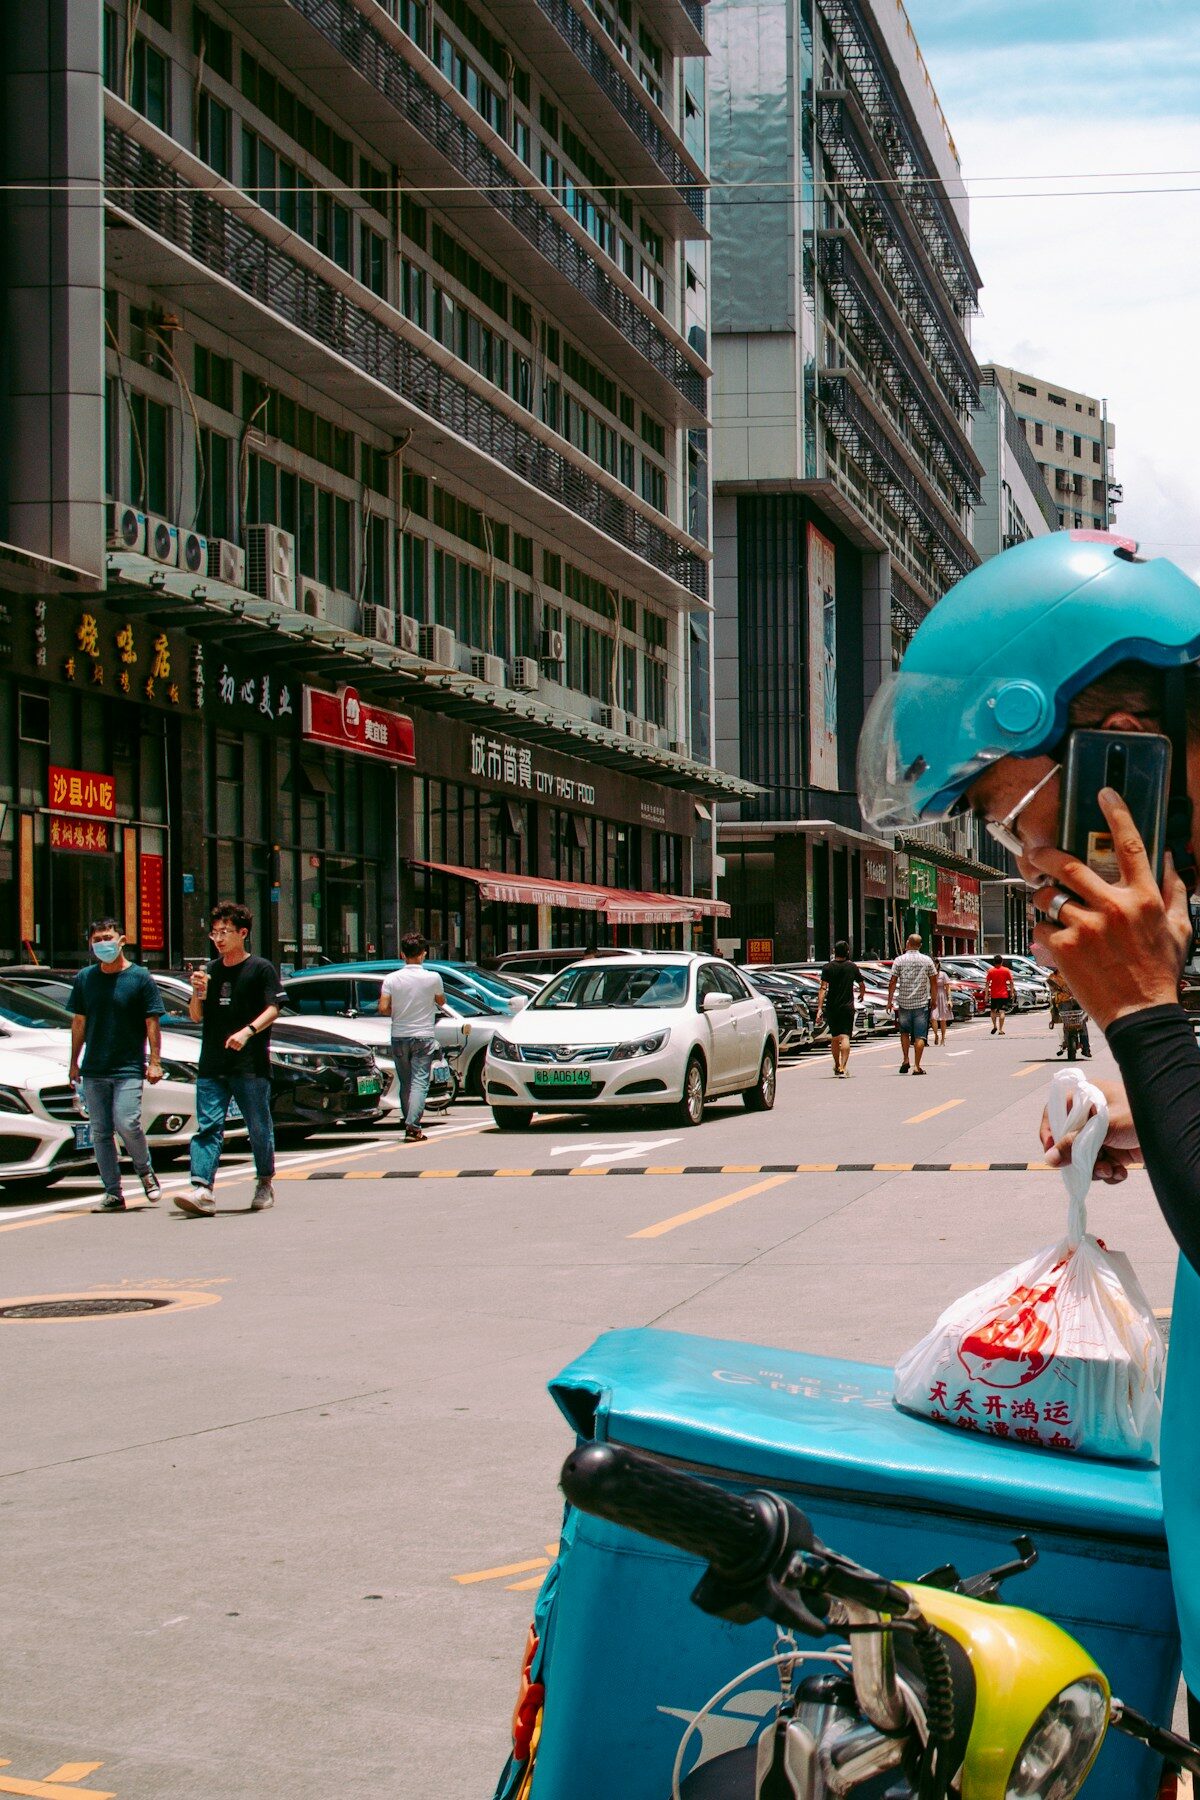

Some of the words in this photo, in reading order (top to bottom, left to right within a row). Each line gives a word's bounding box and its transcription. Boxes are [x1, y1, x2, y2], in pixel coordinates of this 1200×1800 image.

[471, 733, 532, 789] 城市简餐
[535, 770, 553, 795] CITY
[556, 776, 575, 800] FAST
[577, 783, 595, 805] FOOD
[53, 773, 113, 811] 沙县小吃
[928, 1381, 1073, 1426] 天天开鸿运
